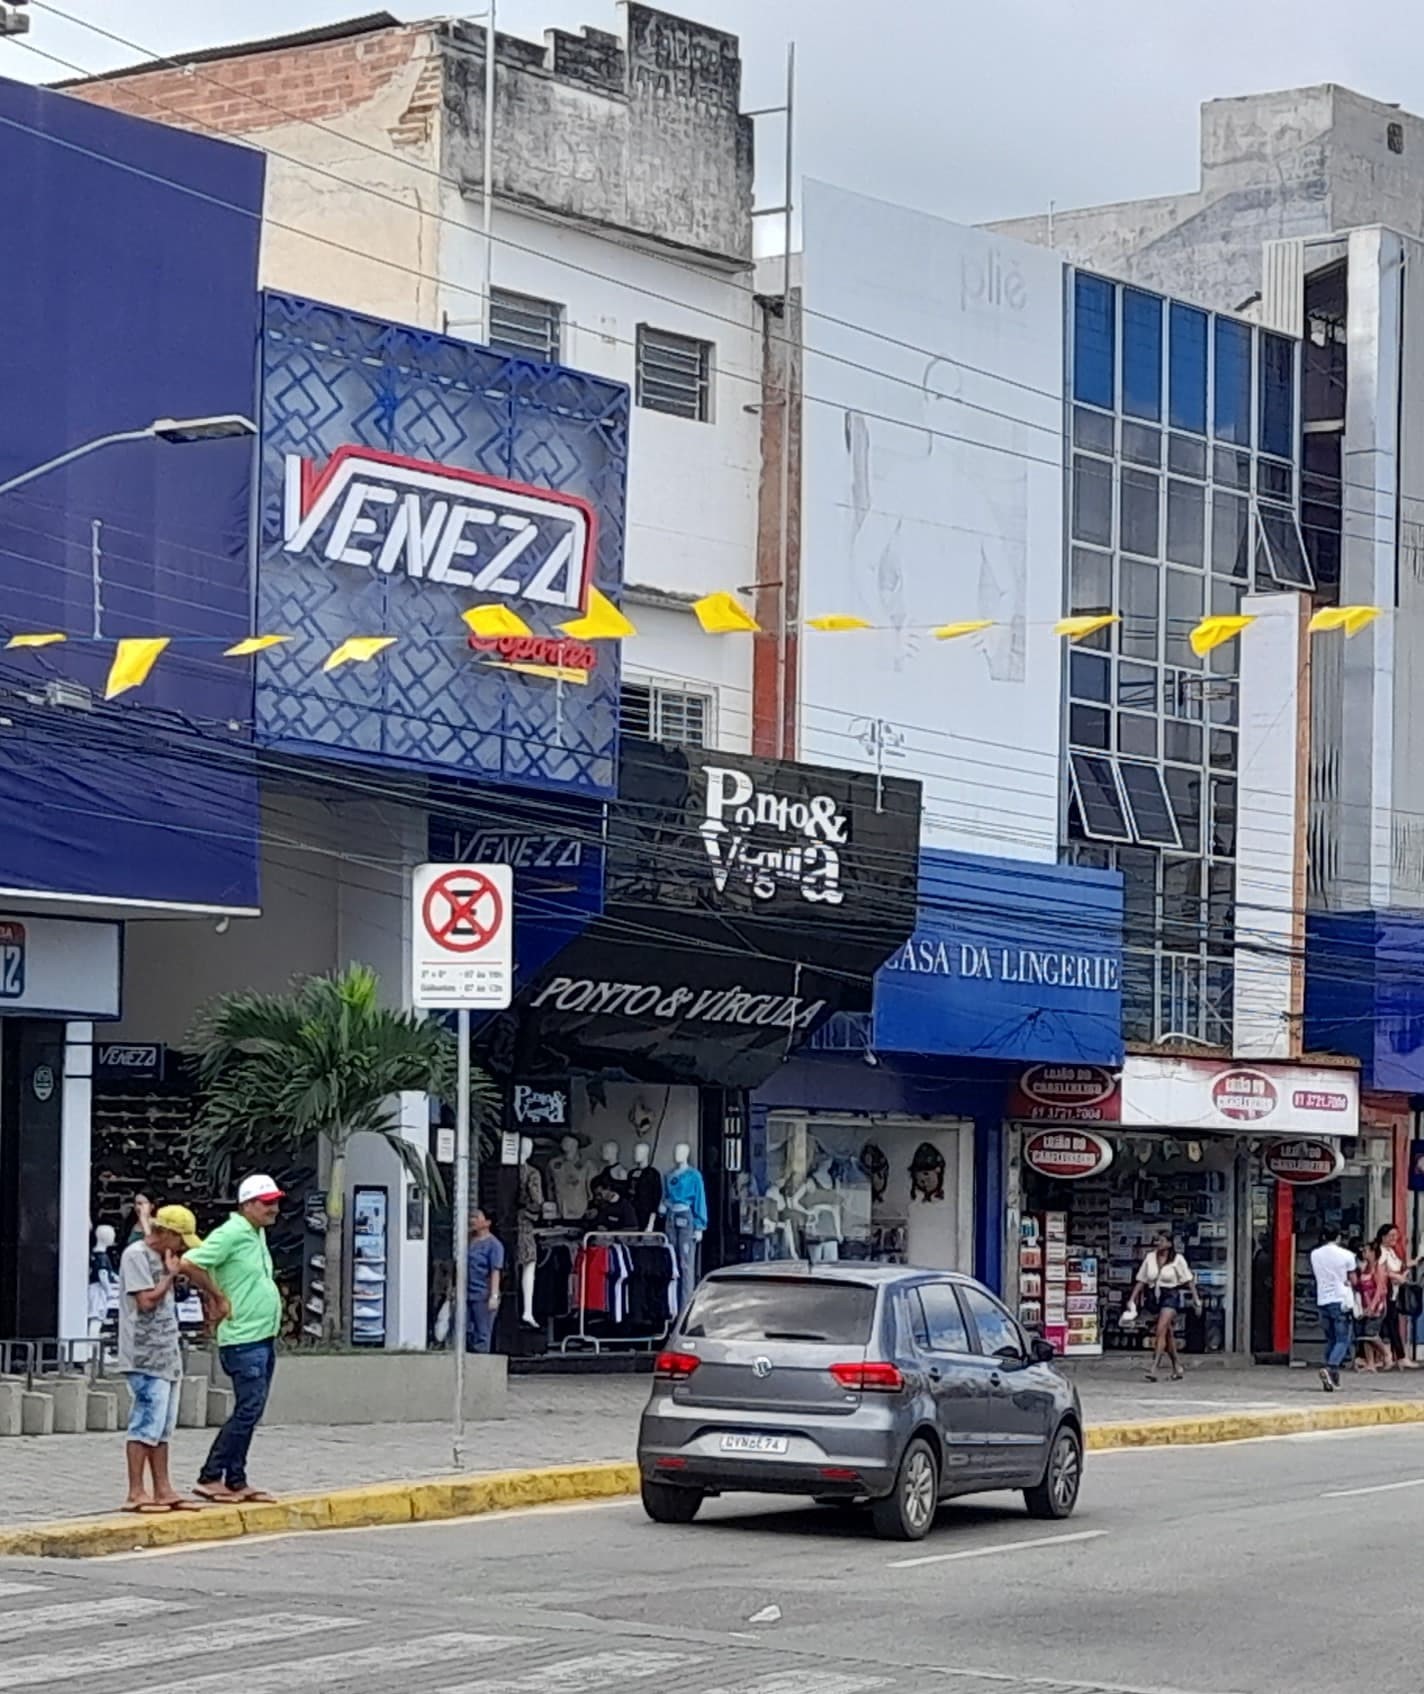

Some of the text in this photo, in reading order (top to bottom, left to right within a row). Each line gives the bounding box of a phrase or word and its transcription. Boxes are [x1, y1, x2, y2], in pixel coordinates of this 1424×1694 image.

[284, 448, 590, 612] VENEZA
[454, 828, 581, 867] VENEZA
[960, 943, 992, 979] DA
[1001, 949, 1118, 990] LINGERIE
[530, 977, 660, 1016] PONTO
